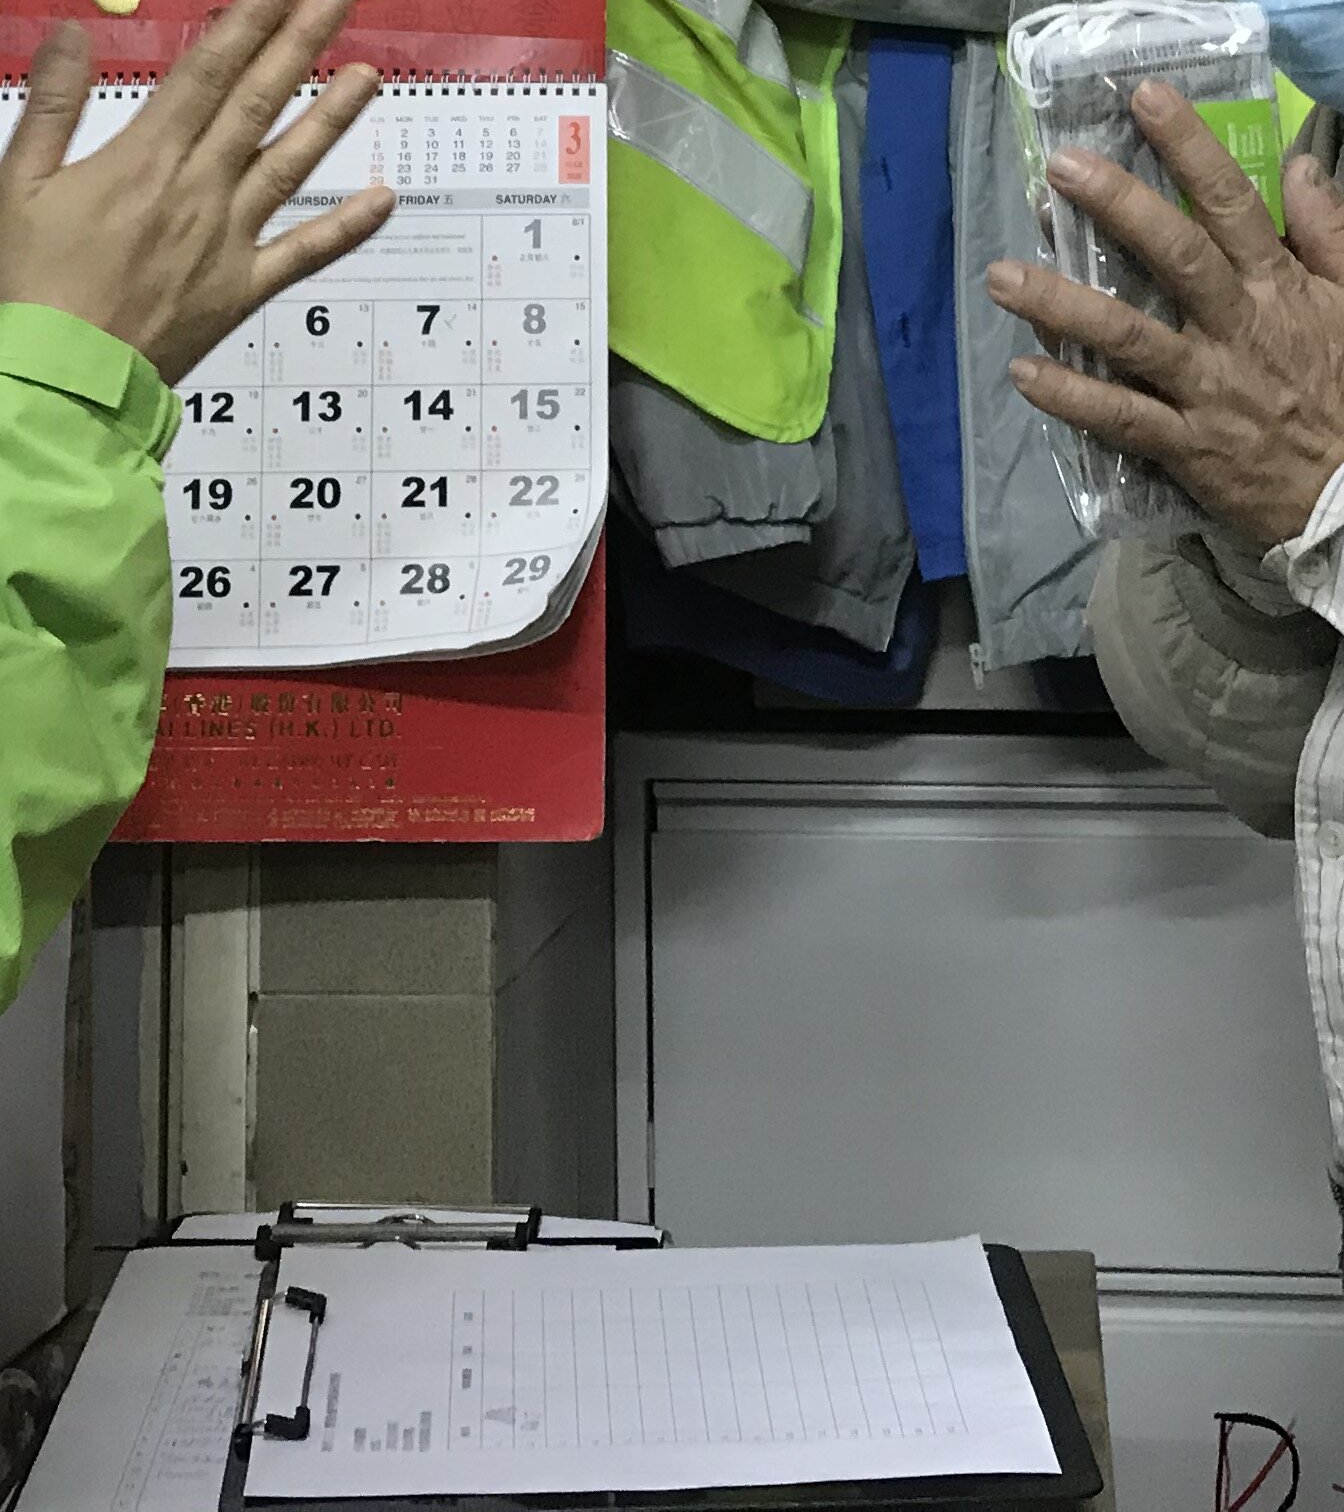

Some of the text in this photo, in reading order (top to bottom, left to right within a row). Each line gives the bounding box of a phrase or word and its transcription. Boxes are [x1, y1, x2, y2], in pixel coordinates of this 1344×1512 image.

[566, 121, 581, 155] 3
[284, 196, 343, 206] HURSDAY
[399, 195, 440, 206] FRIDAY
[496, 194, 557, 204] SATURDAY
[524, 219, 541, 248] 1
[306, 306, 330, 336] 6
[417, 305, 440, 335] 7
[523, 304, 546, 334] 8
[185, 393, 233, 423] 12
[293, 391, 341, 422] 13
[404, 390, 453, 420] 14
[511, 389, 559, 419] 15
[184, 479, 232, 510] 19
[290, 478, 341, 509] 20
[402, 477, 447, 507] 21
[509, 475, 559, 506] 22
[179, 566, 231, 597] 26
[289, 566, 340, 596] 27
[400, 564, 450, 594] 28
[503, 555, 551, 586] 29
[161, 691, 402, 717] (香港)股份有限公司
